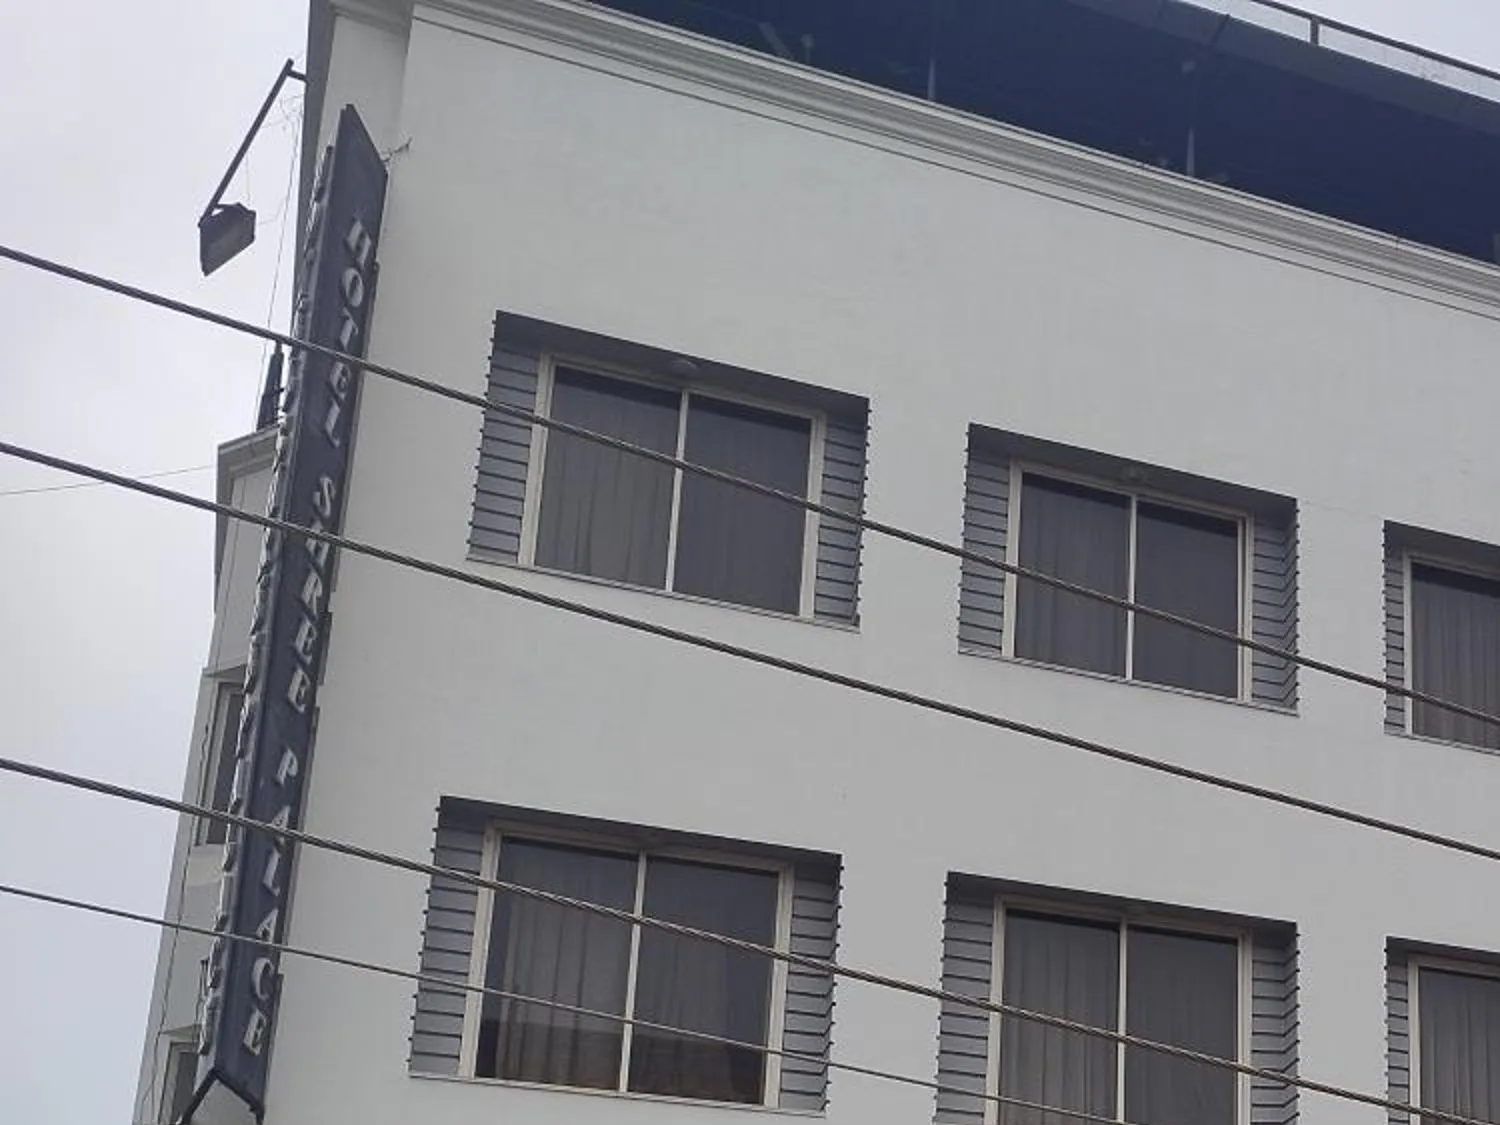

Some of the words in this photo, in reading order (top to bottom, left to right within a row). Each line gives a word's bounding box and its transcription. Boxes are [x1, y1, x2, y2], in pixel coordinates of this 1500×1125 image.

[324, 220, 372, 448] HOTEL
[288, 475, 336, 713] SHREE
[243, 746, 298, 1056] PALACE
